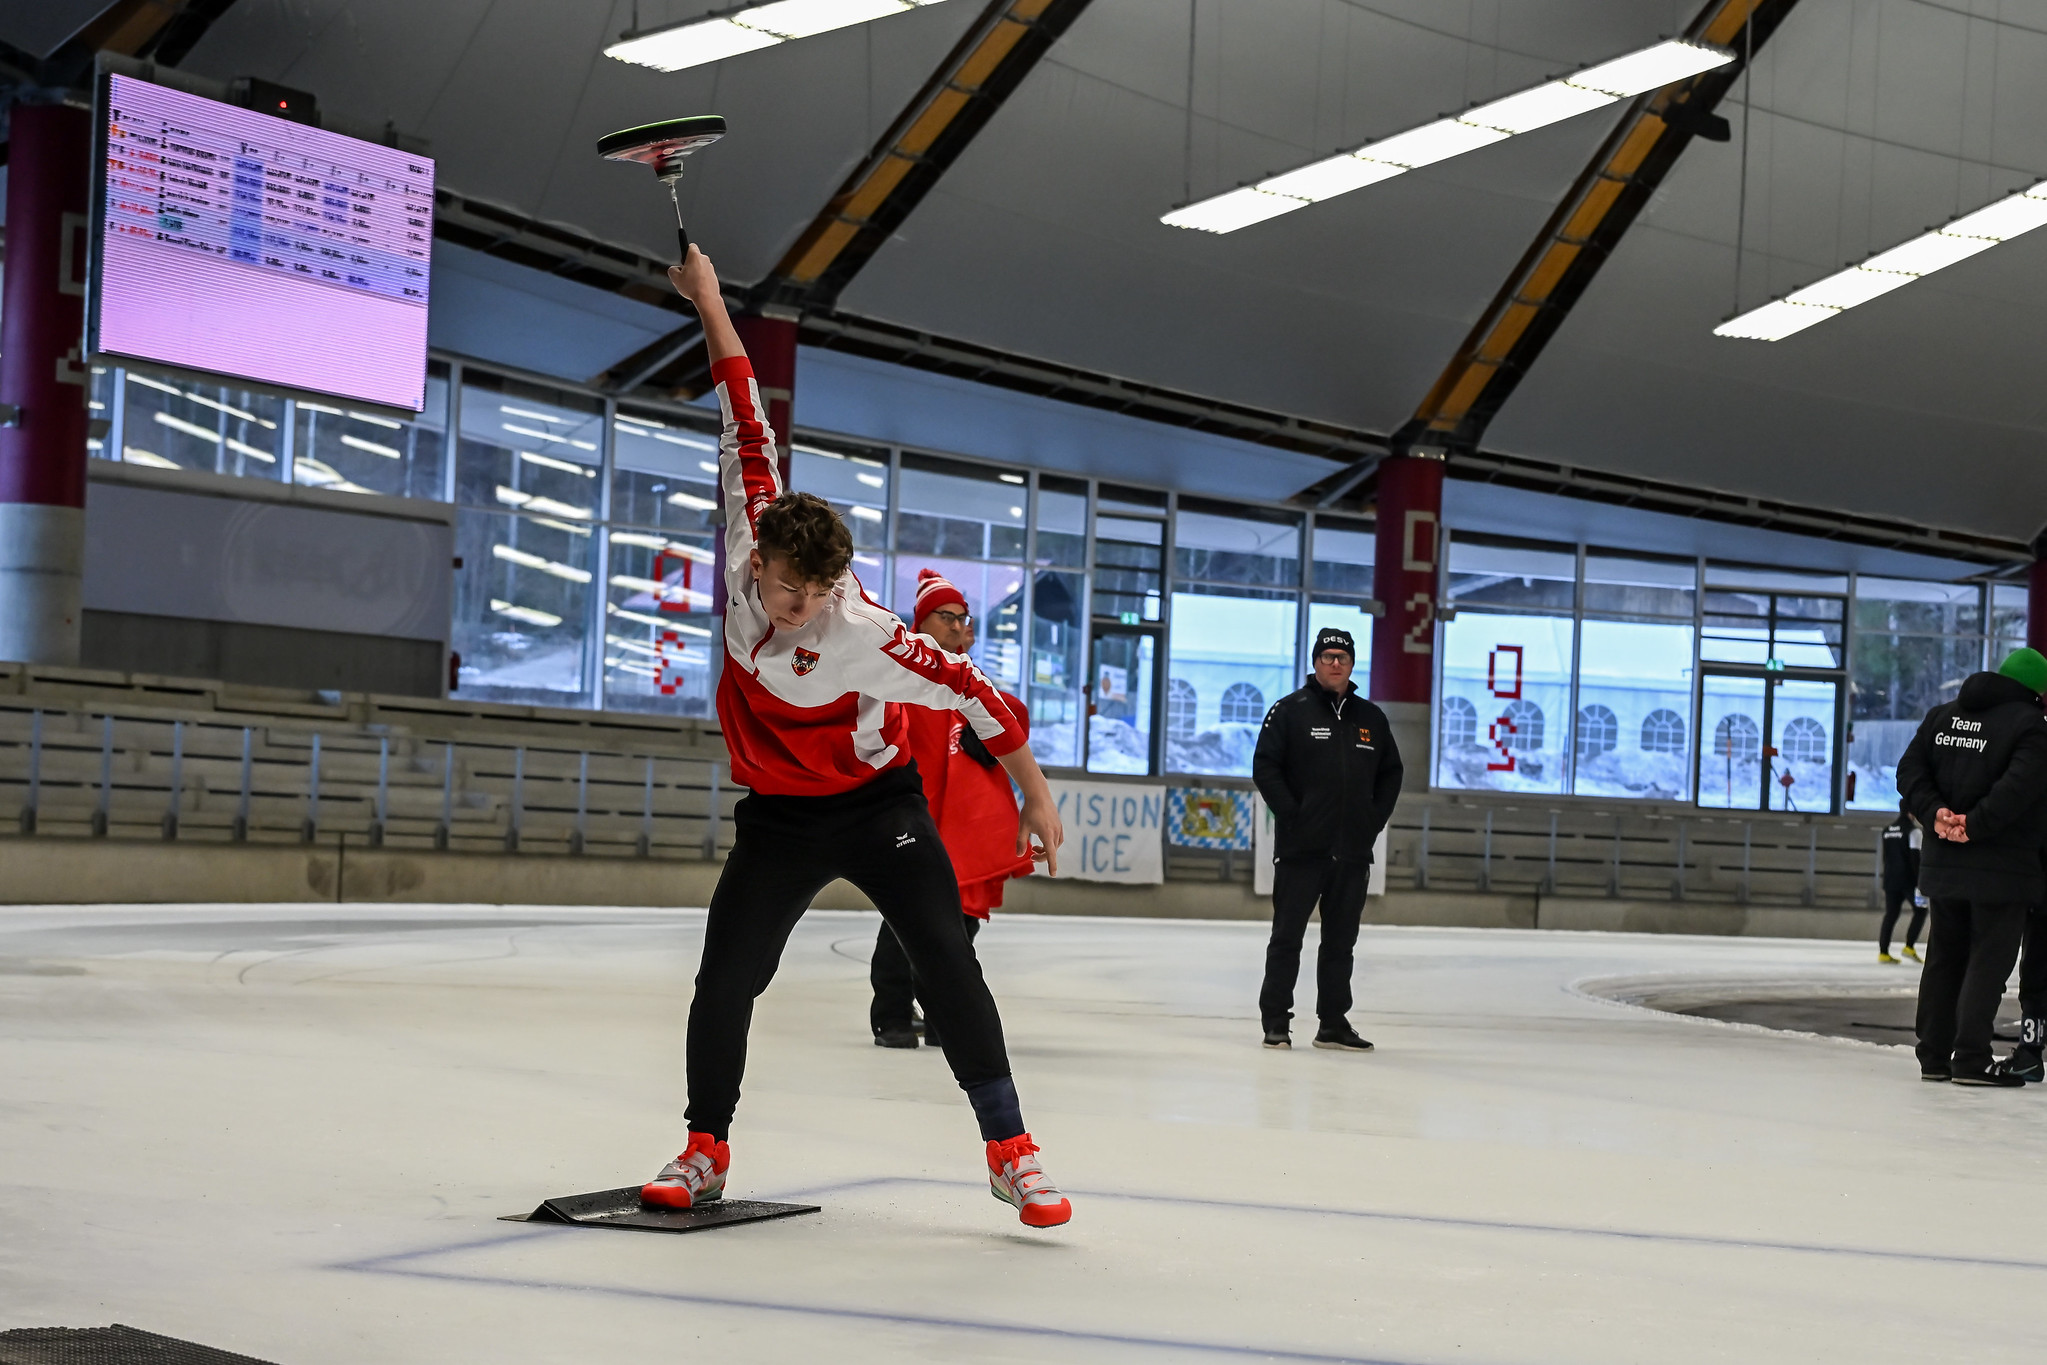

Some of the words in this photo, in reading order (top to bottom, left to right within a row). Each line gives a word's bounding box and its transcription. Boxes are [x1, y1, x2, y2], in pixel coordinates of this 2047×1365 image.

[1323, 635, 1350, 646] DESV
[1951, 716, 1982, 732] Team
[1935, 732, 1988, 752] Germany
[896, 837, 916, 848] erima
[1081, 834, 1132, 873] ICE
[2023, 1018, 2036, 1043] 3
